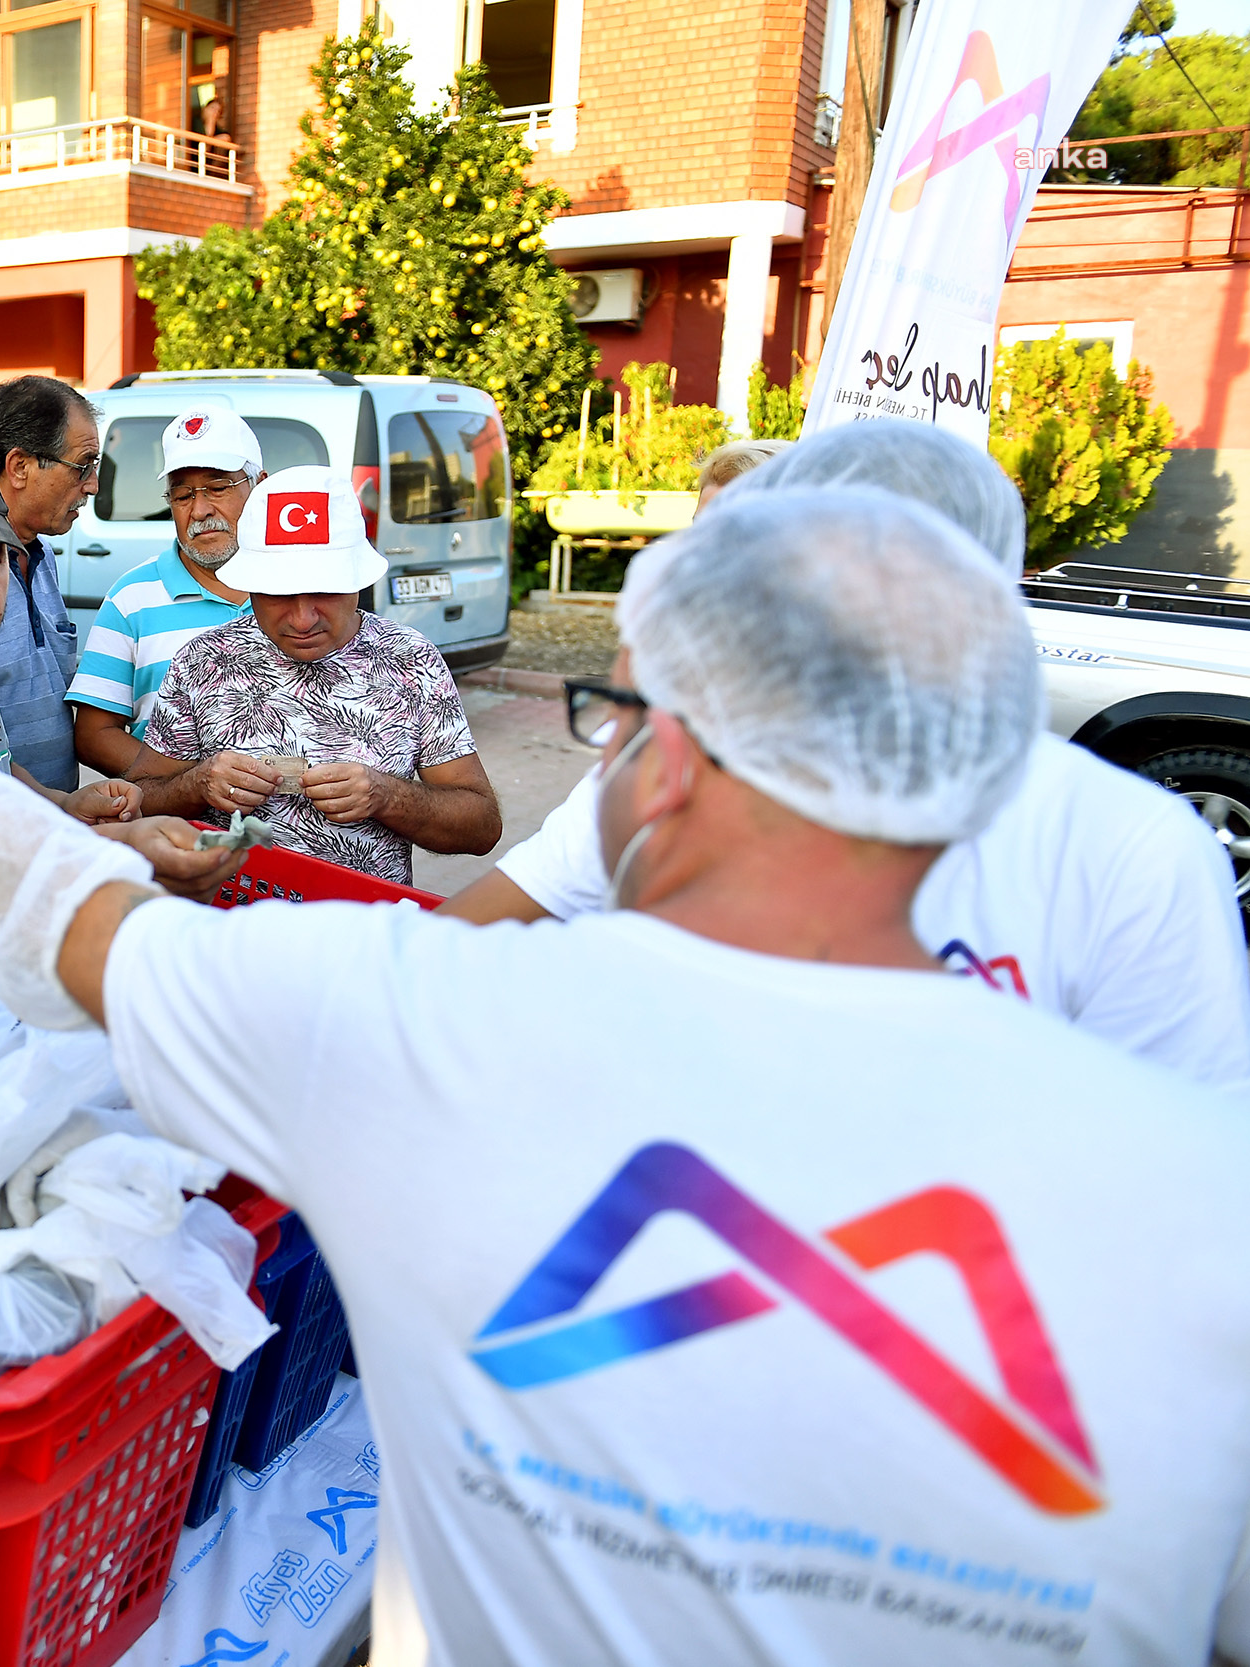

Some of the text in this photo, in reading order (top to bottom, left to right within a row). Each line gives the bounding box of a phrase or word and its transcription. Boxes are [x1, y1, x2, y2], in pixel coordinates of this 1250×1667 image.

[396, 580, 410, 596] 33
[243, 1552, 307, 1622] Afiyet
[287, 1562, 347, 1624] Olsun
